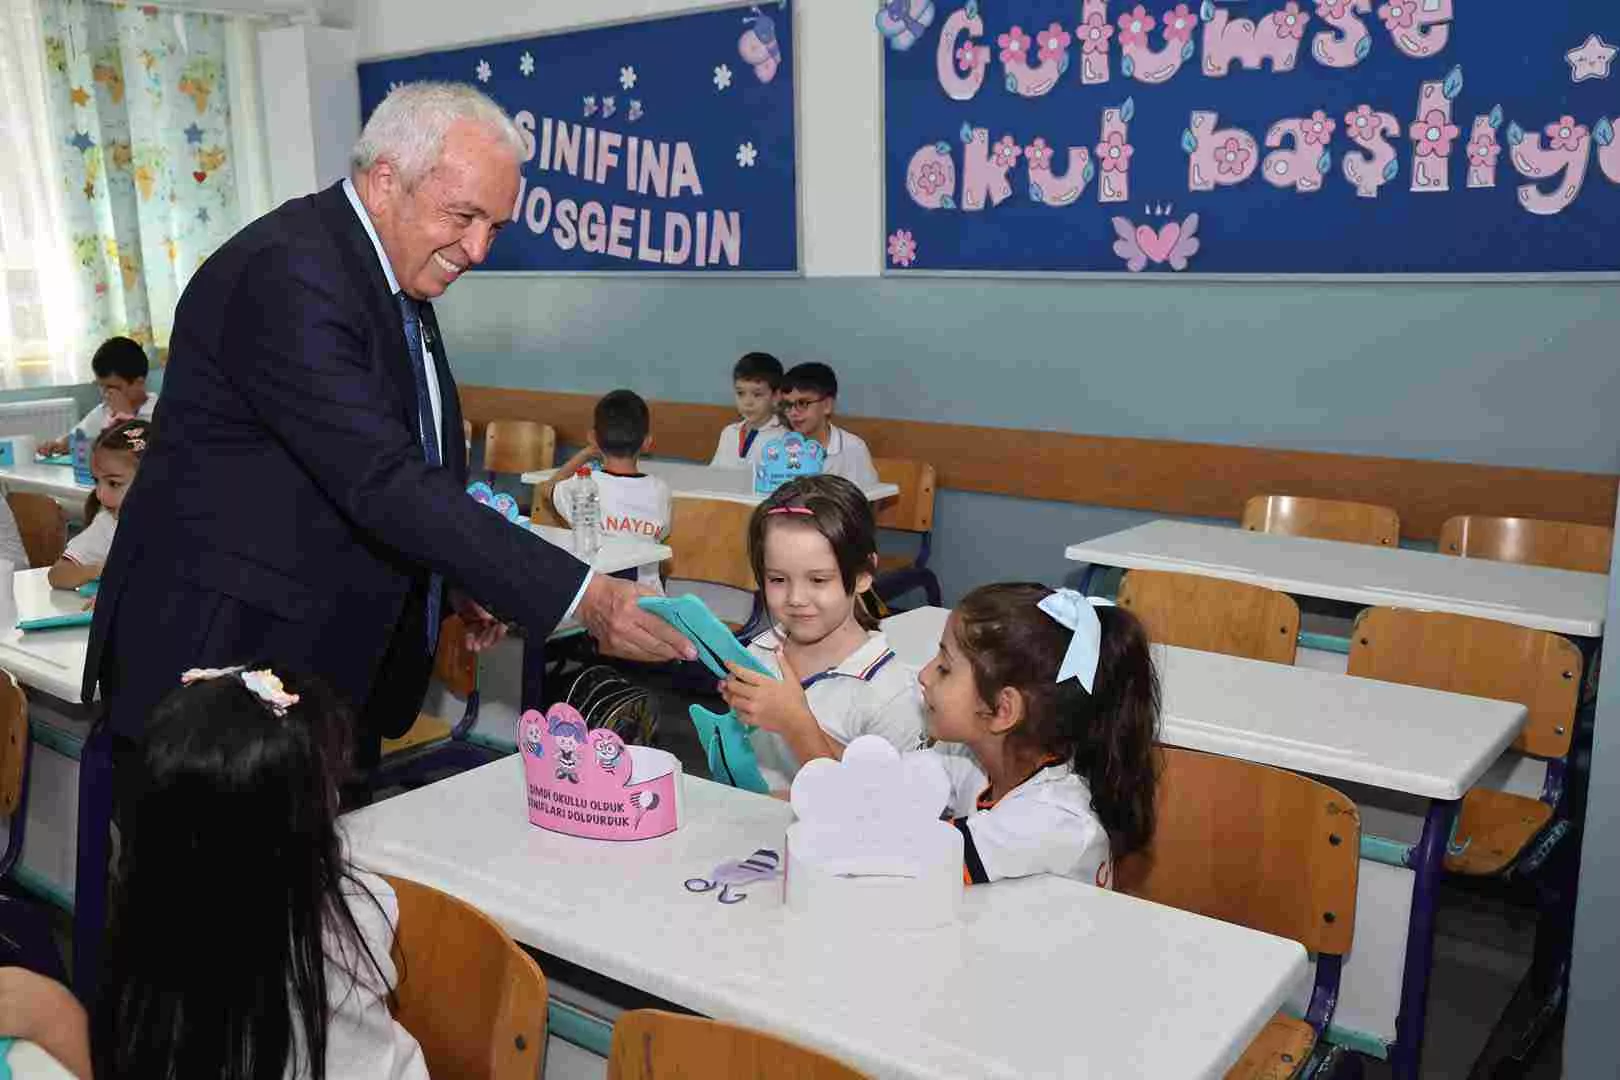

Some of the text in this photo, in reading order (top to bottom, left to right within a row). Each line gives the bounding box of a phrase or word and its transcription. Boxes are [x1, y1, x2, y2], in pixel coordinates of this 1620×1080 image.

[906, 100, 1131, 212] okul
[590, 800, 625, 813] OLDUK
[568, 809, 630, 827] DOLDURDUK
